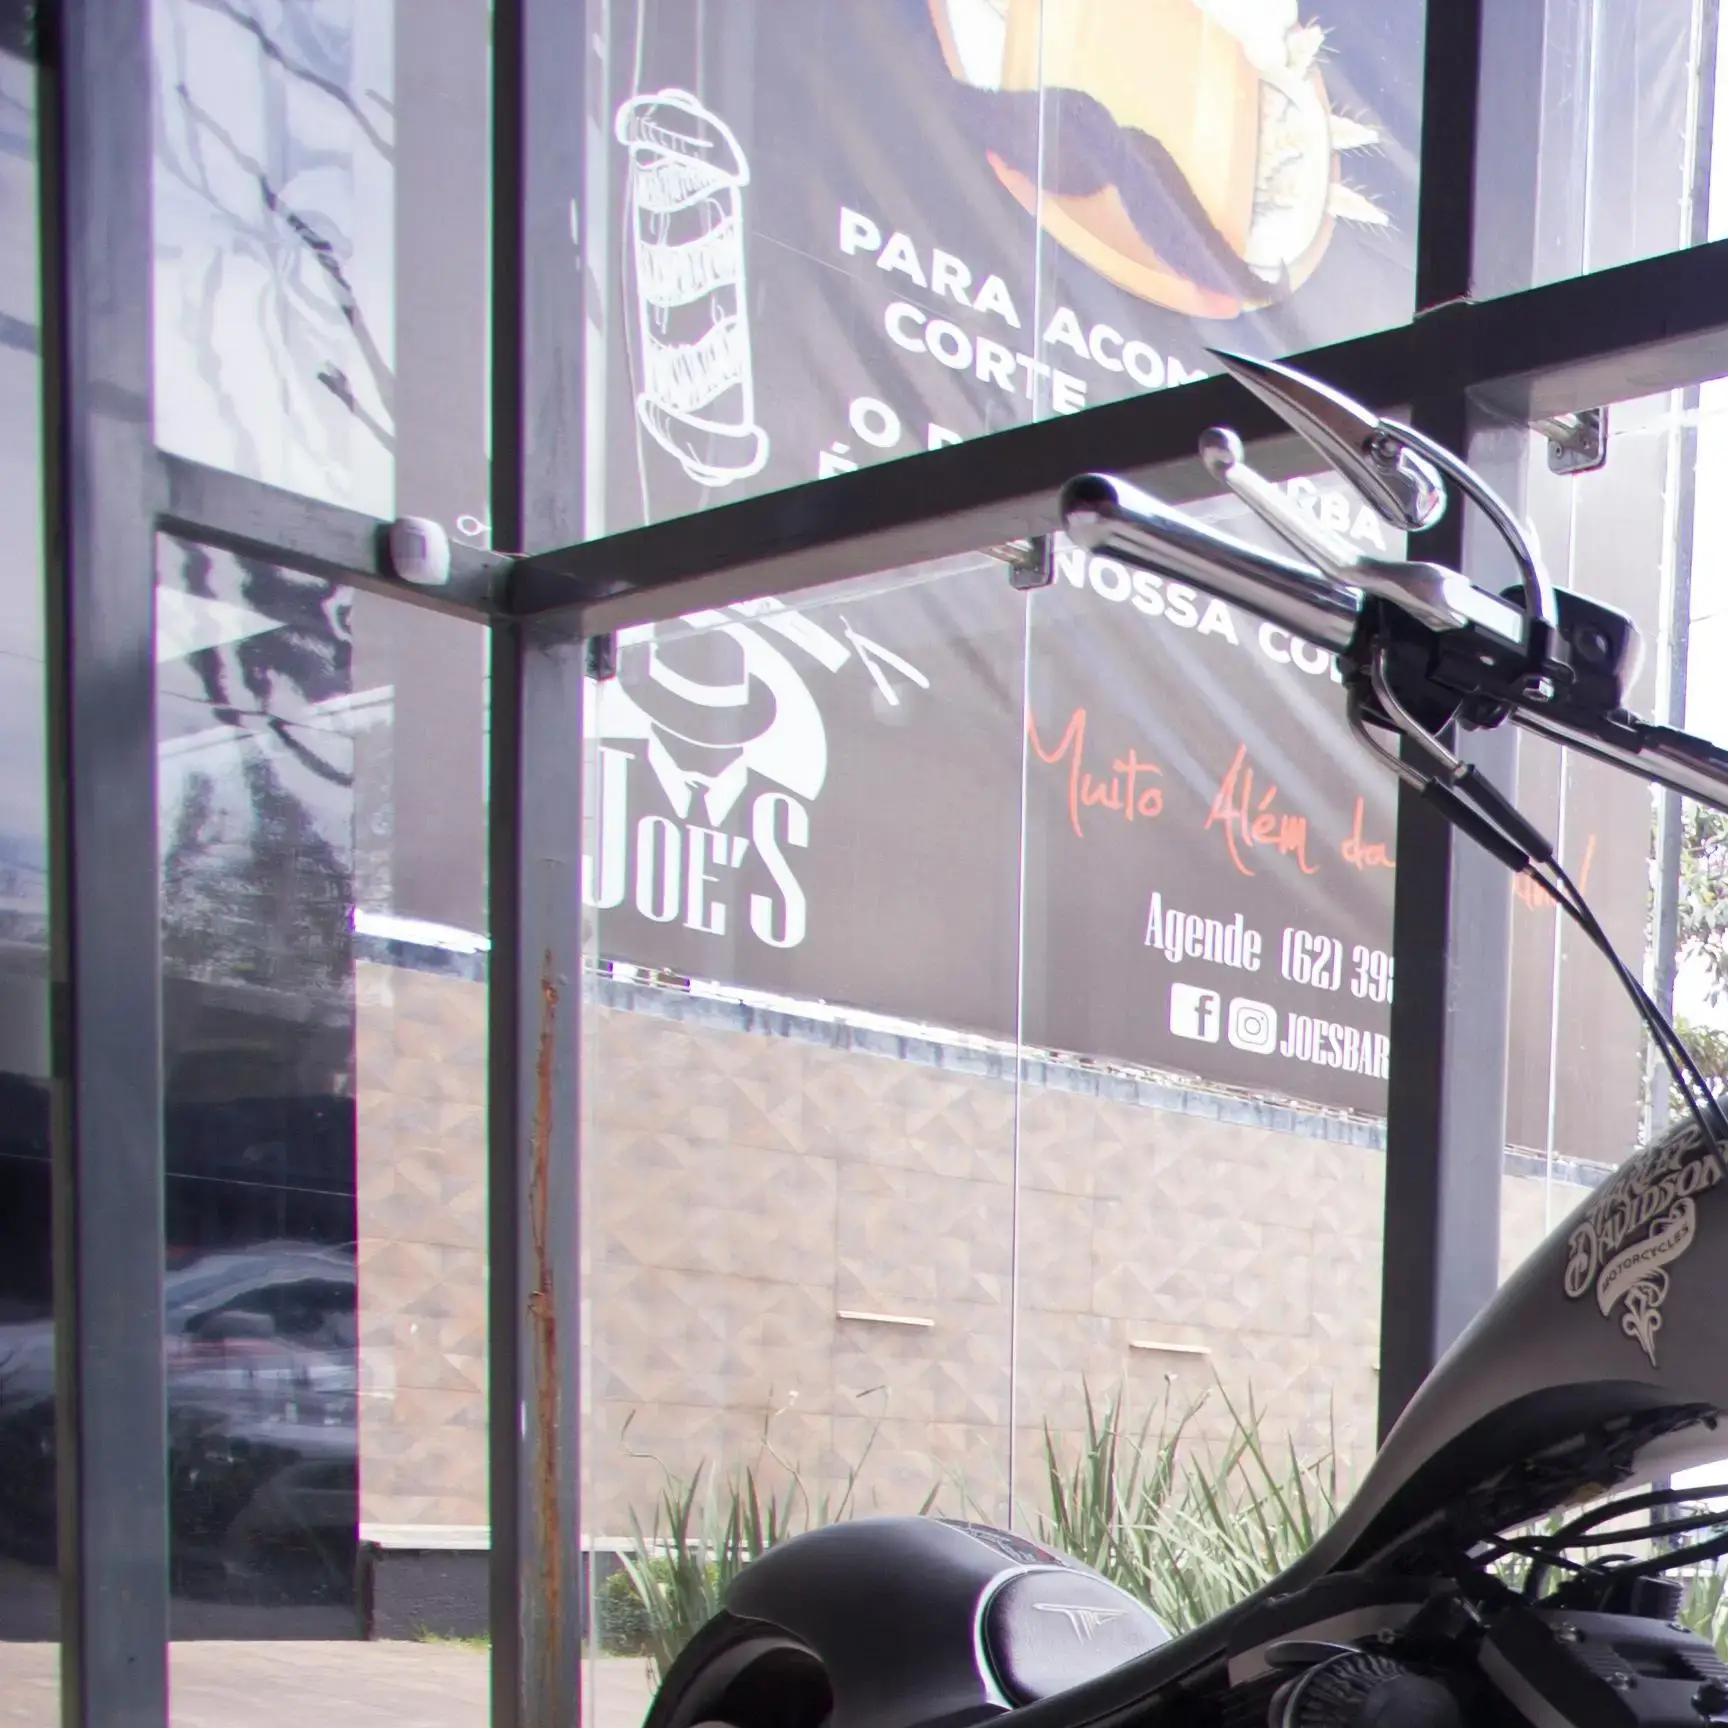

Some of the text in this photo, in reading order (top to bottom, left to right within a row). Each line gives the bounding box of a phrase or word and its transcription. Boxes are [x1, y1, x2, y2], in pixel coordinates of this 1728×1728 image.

[839, 206, 1021, 329] PARA
[884, 302, 1088, 415] CORTE
[849, 396, 901, 448] O
[1052, 548, 1240, 647] NOSSA
[1027, 707, 1163, 839] Muito
[1204, 743, 1320, 876] Além
[1144, 891, 1262, 972] Agende
[1280, 927, 1343, 991] (62)
[1280, 1012, 1390, 1080] JOESBAR
[1601, 1222, 1690, 1294] MOTORCYCLES
